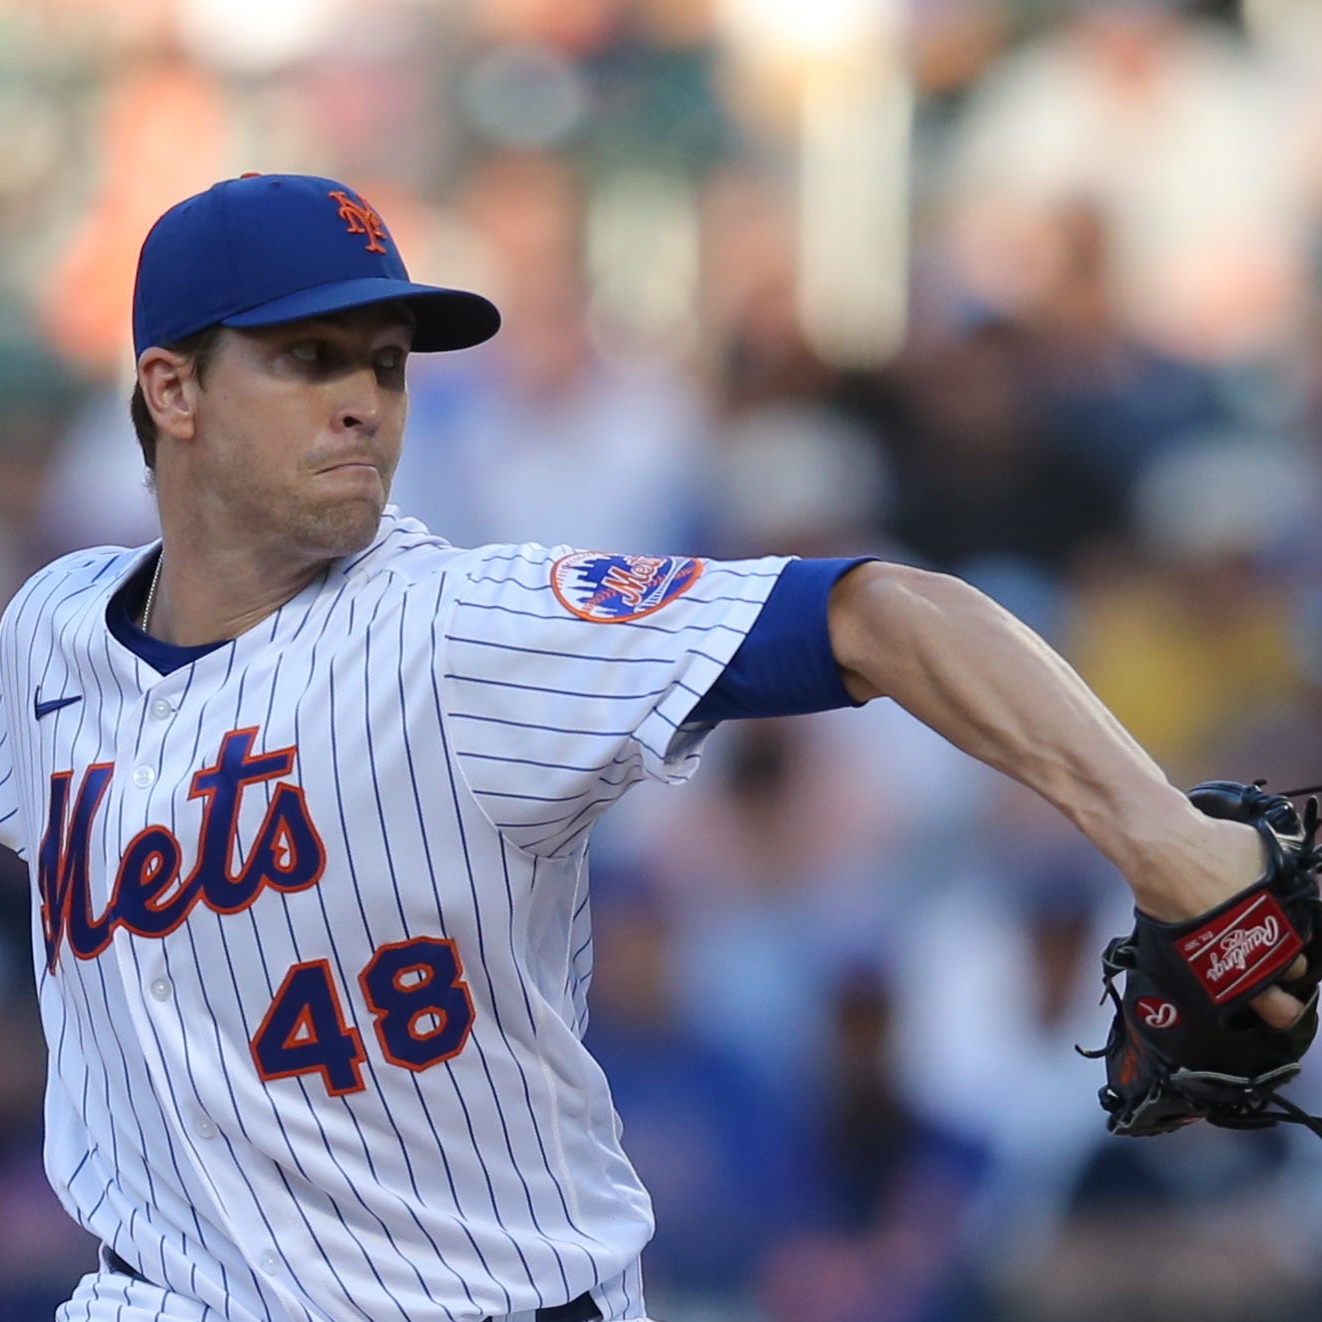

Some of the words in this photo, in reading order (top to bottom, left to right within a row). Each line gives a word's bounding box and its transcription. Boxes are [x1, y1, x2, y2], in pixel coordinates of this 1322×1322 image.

[601, 556, 667, 607] Met
[39, 726, 327, 976] Mets
[1207, 915, 1279, 982] Rawlings
[250, 936, 476, 1097] 48
